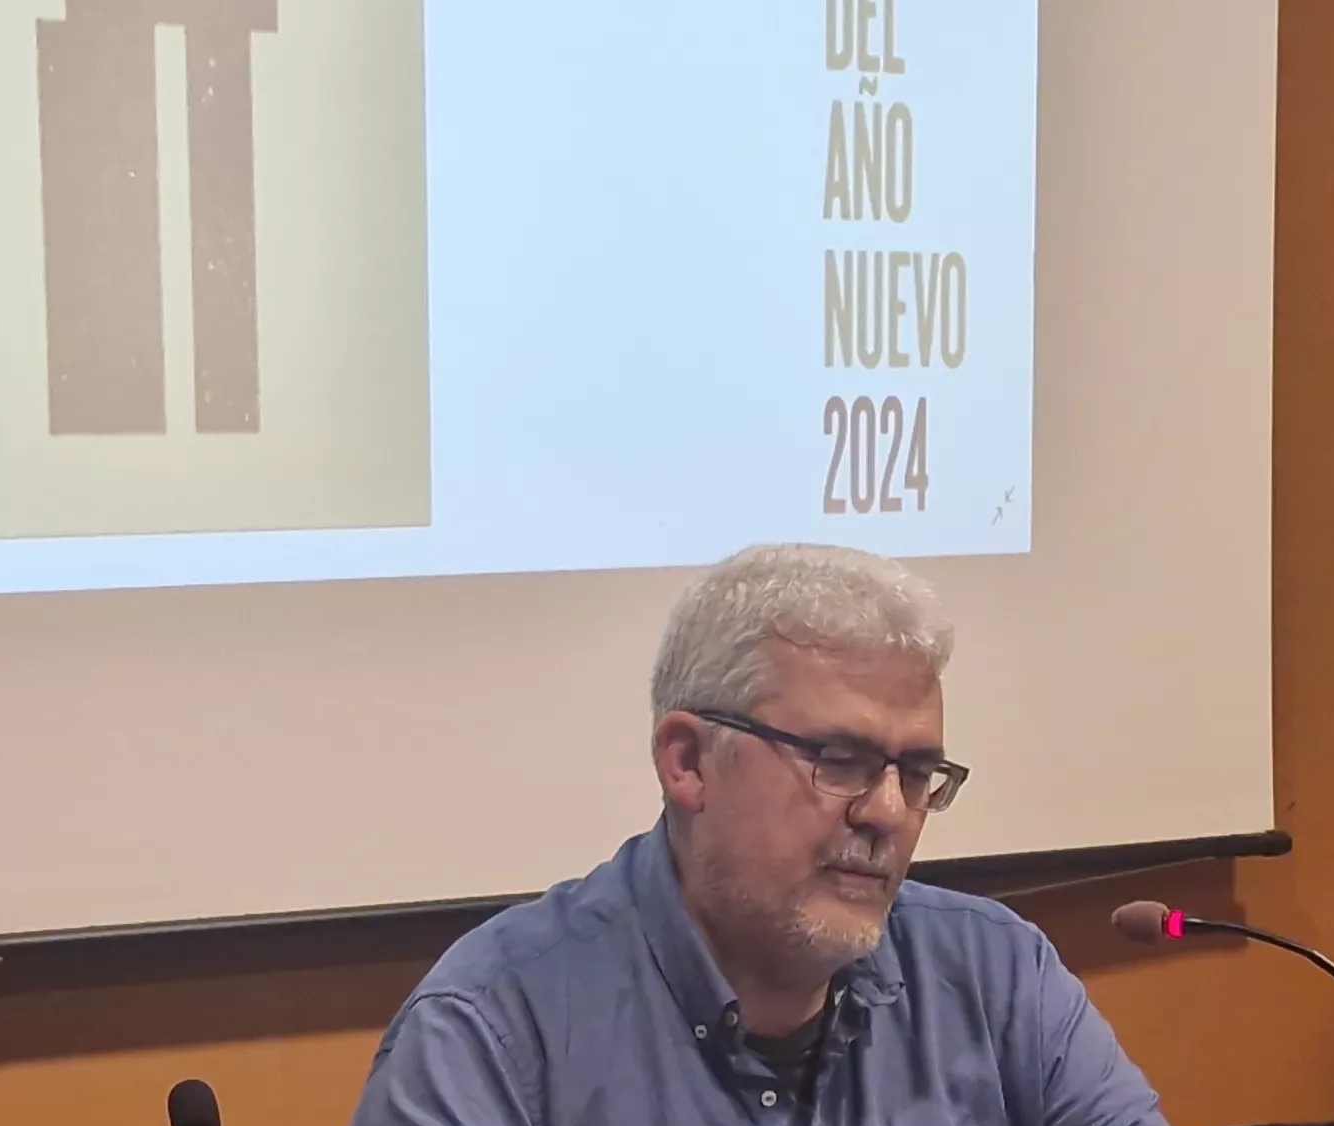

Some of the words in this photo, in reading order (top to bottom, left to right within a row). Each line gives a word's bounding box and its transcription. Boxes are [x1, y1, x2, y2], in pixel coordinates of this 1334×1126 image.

[825, 0, 905, 74] DEL
[823, 76, 913, 223] AÑO
[824, 249, 966, 369] NUEVO
[823, 395, 929, 514] 2024
